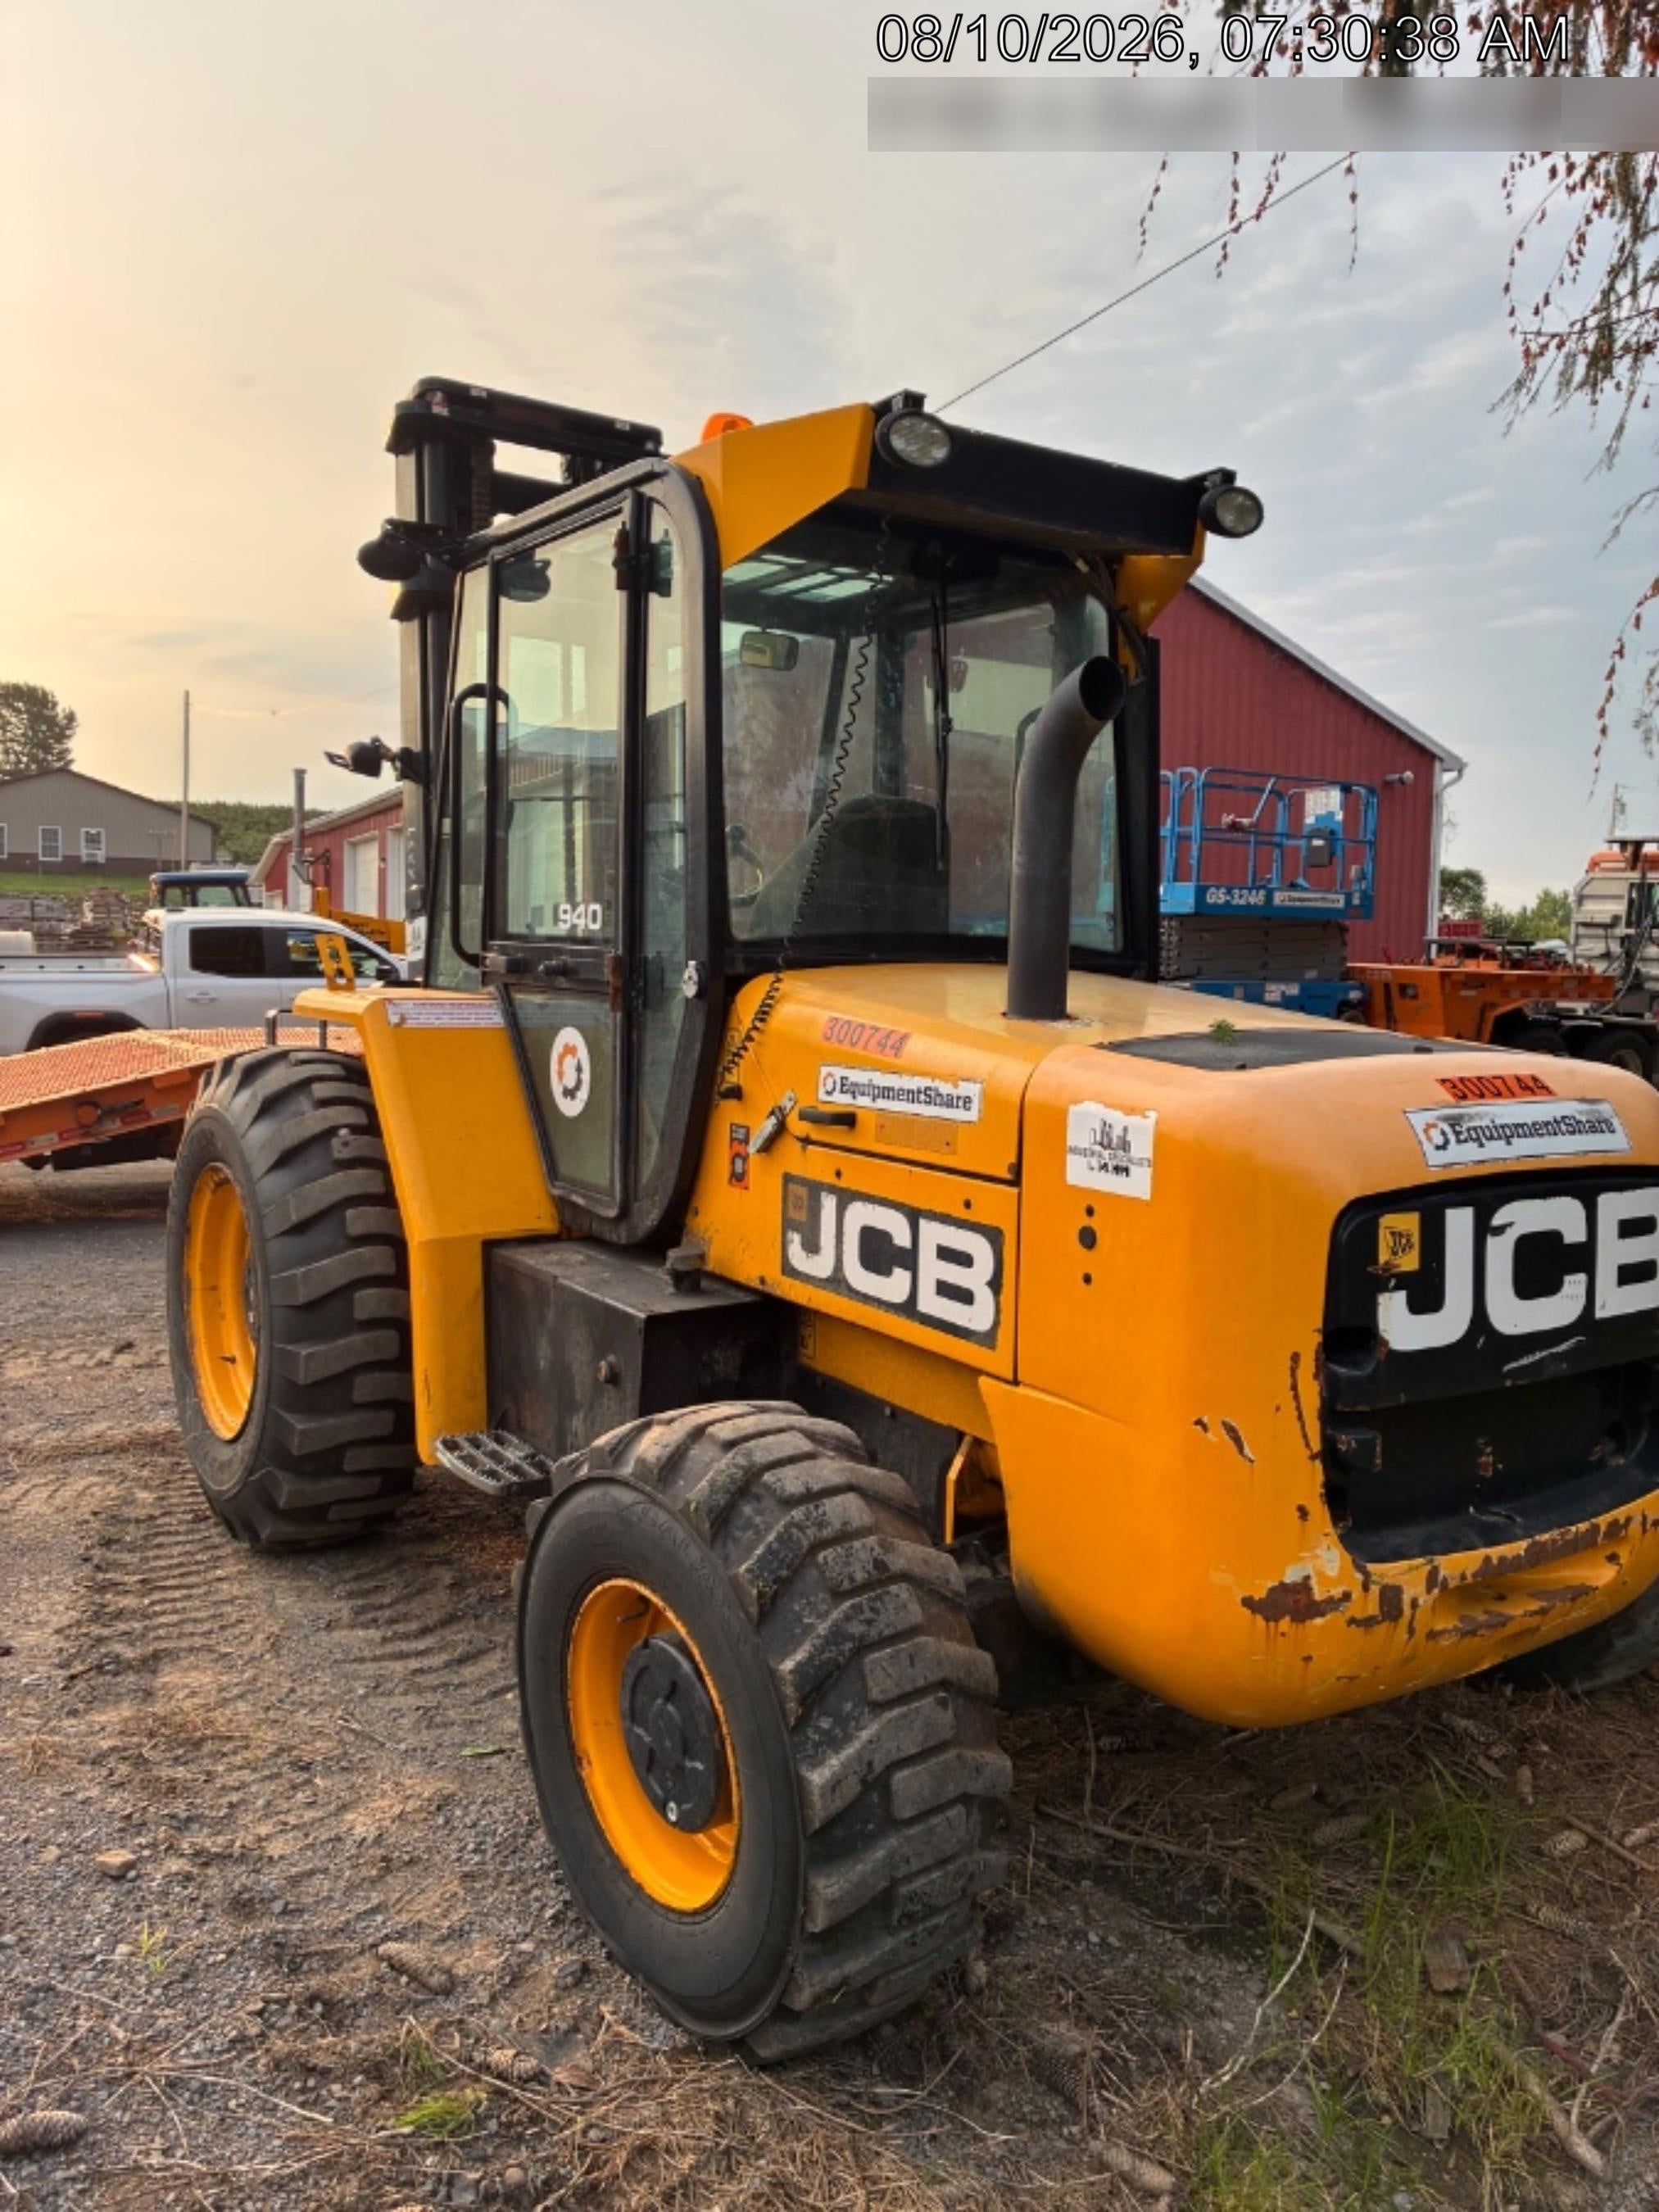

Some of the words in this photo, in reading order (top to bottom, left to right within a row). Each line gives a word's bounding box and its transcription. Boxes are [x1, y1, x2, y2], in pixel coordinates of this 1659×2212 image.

[1205, 886, 1267, 906] GS-3246
[556, 904, 603, 931] 940
[823, 1017, 910, 1058] 300744
[840, 1076, 973, 1111] EquipmentShare
[1439, 1074, 1553, 1100] 300744
[1448, 1114, 1616, 1148] EquipmentShare
[787, 1191, 996, 1333] JCB
[1376, 1186, 1659, 1352] JCB
